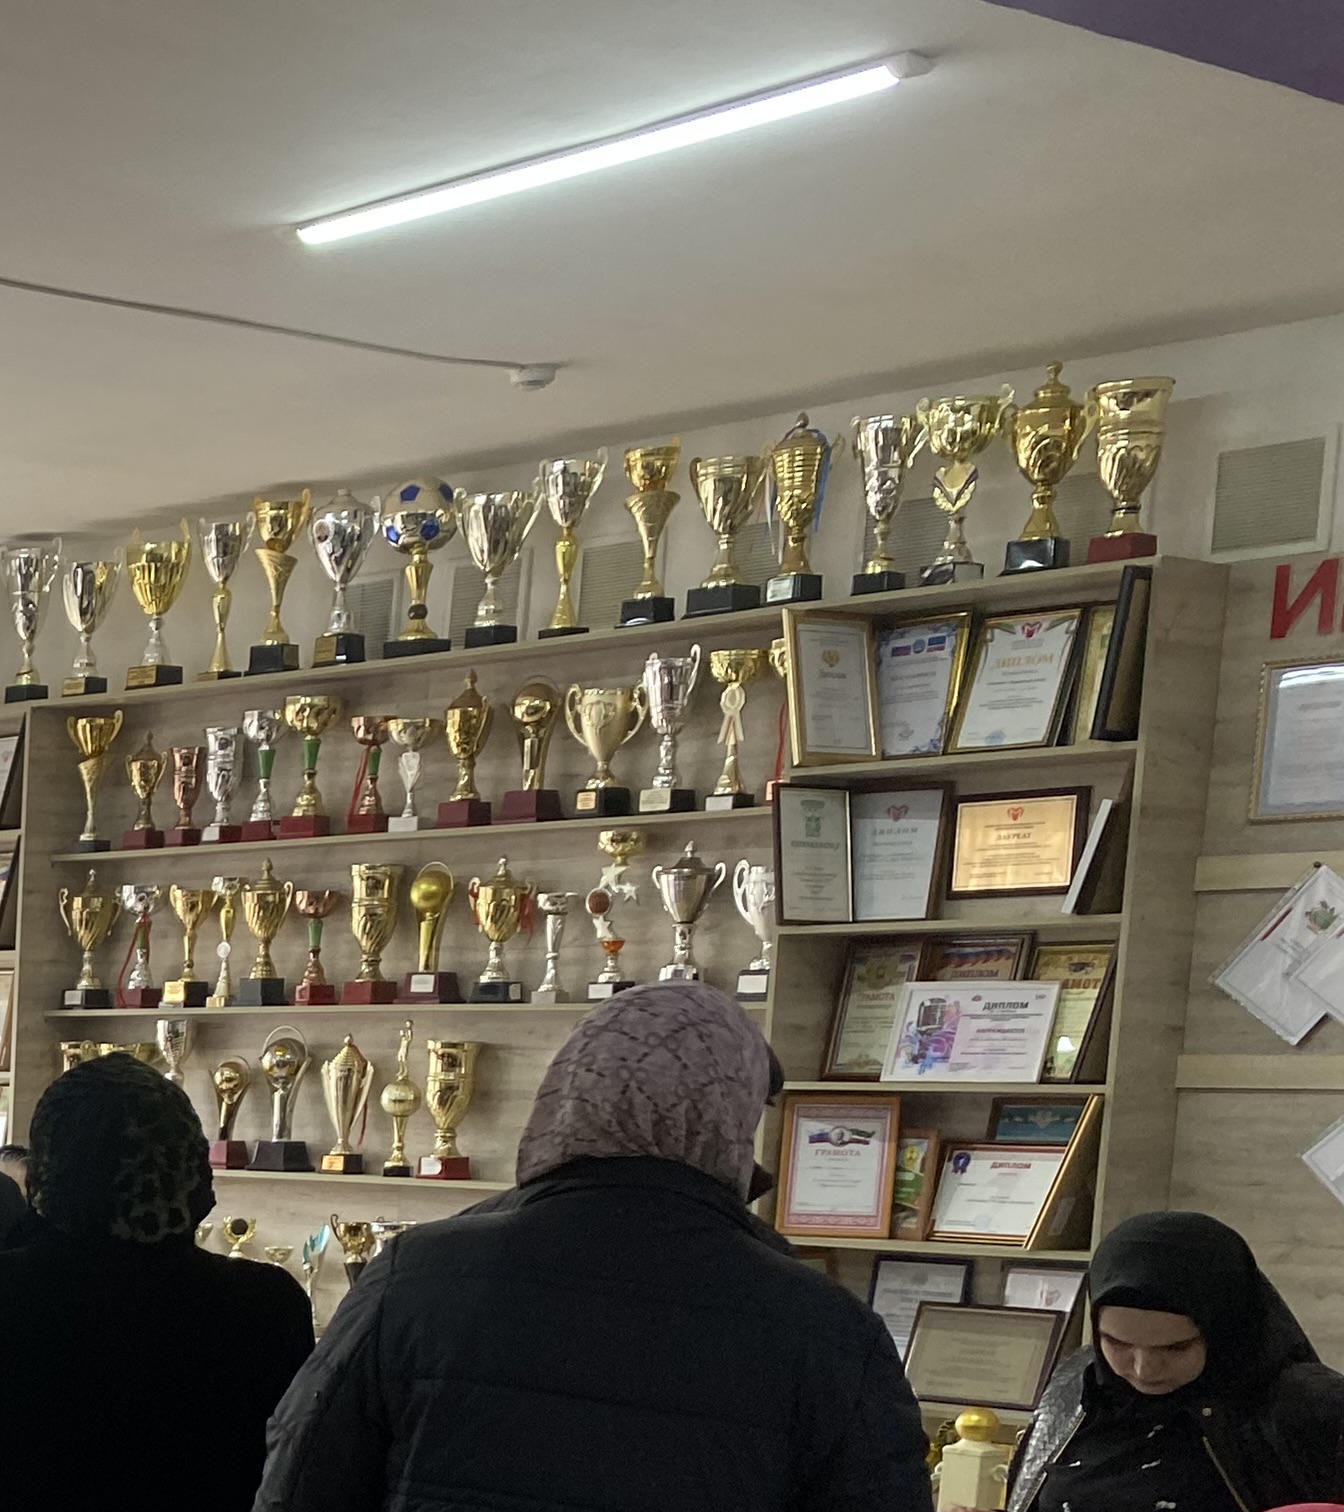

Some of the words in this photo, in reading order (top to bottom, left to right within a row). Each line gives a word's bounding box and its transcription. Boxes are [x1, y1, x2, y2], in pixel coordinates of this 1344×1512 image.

[1270, 557, 1344, 639] И
[1062, 978, 1102, 990] АМОТ
[982, 1001, 1029, 1011] ДИПЛОМ
[815, 1149, 862, 1157] ГРАМОТА
[990, 1161, 1032, 1169] ДИПЛОМ
